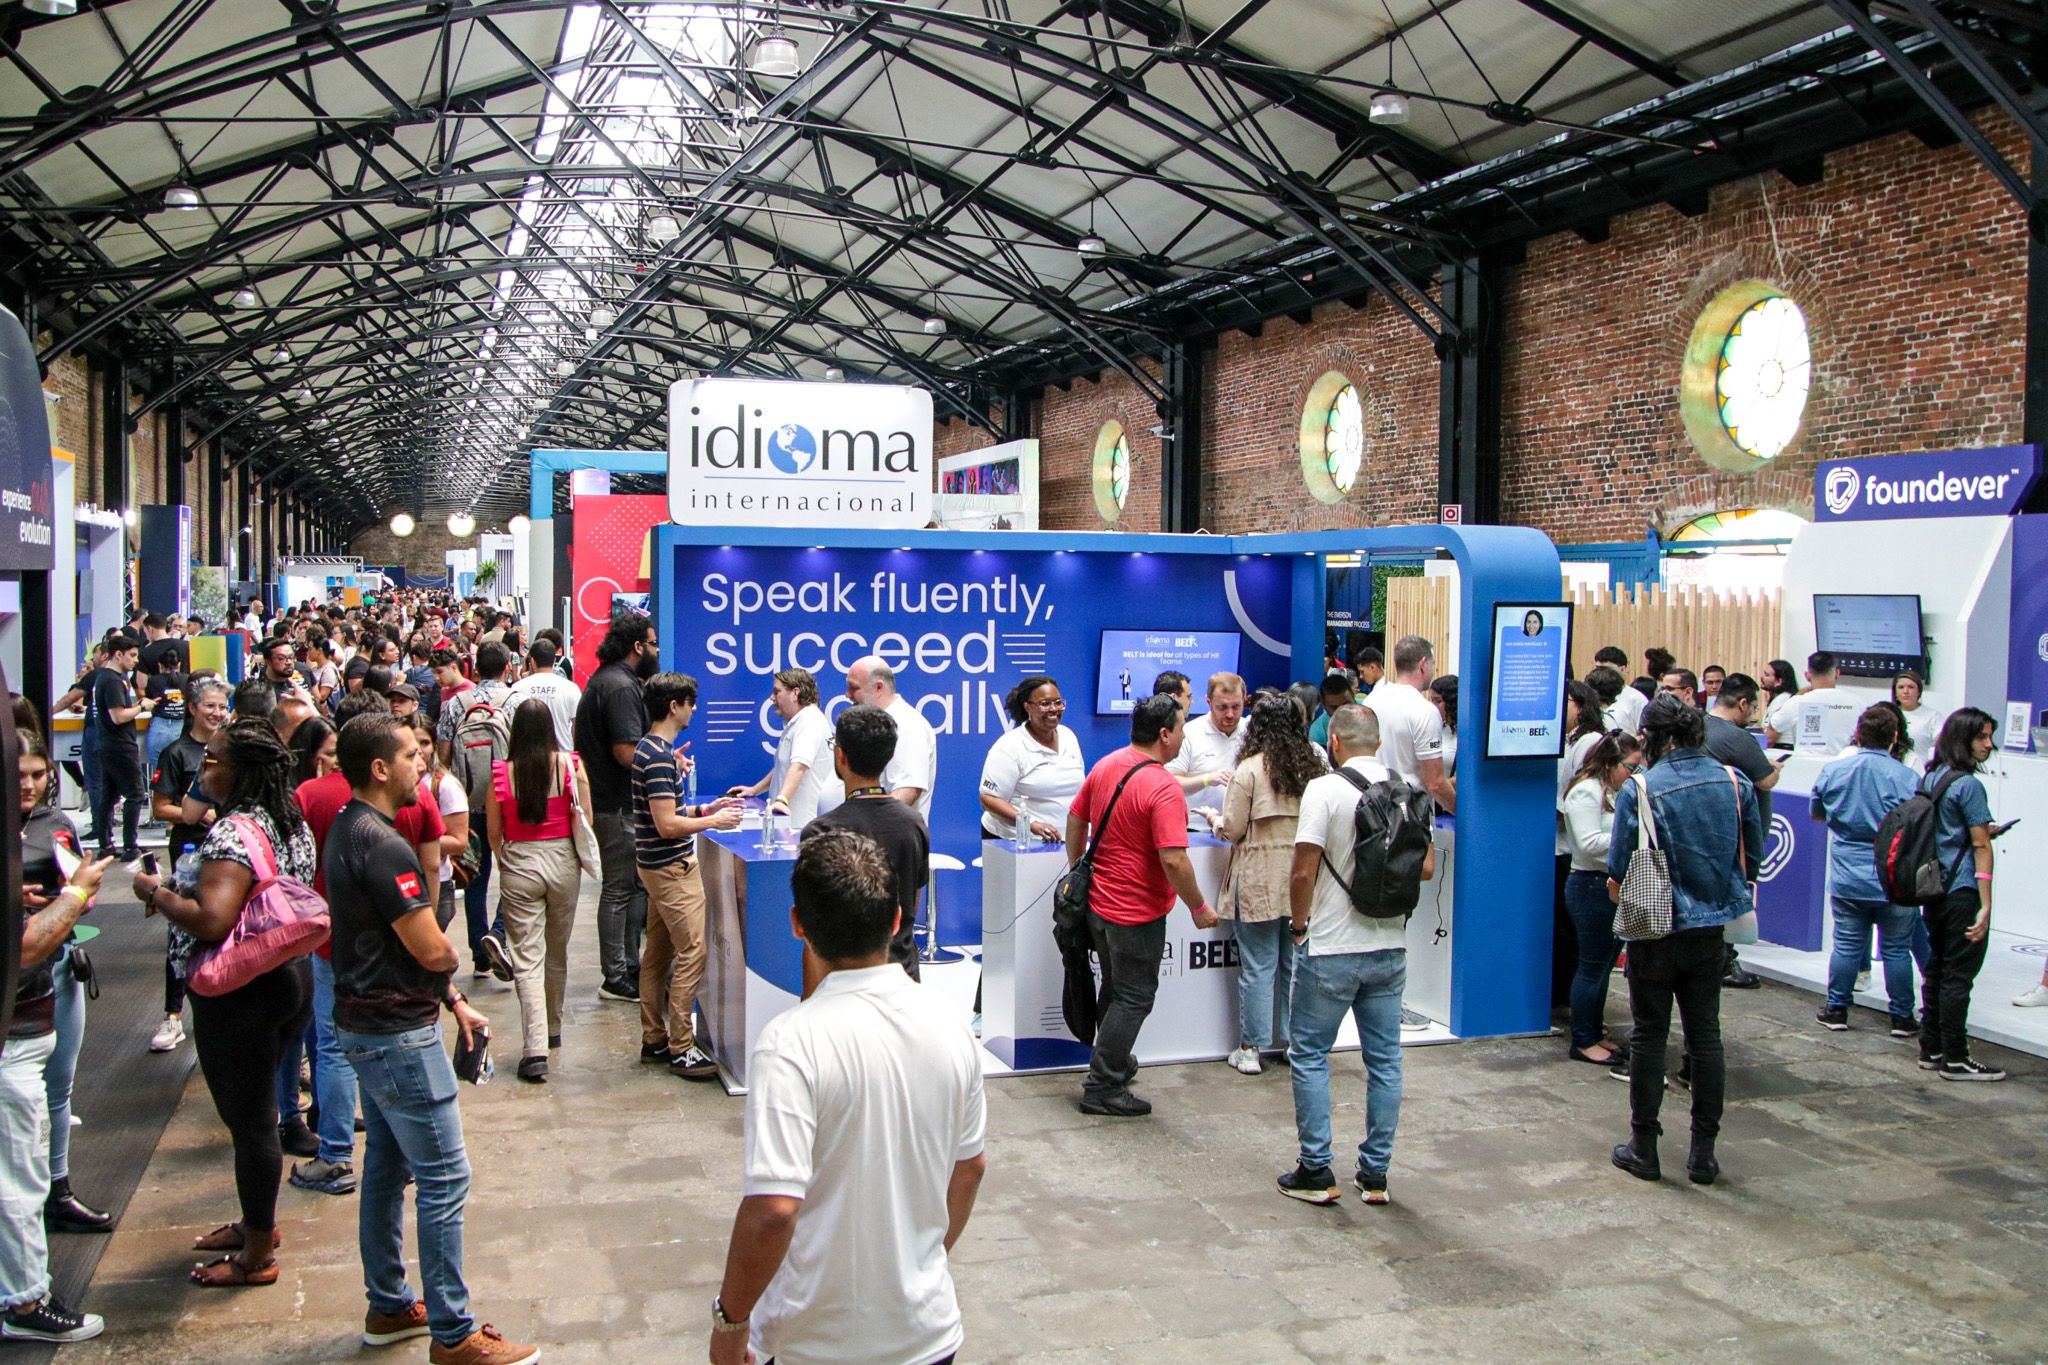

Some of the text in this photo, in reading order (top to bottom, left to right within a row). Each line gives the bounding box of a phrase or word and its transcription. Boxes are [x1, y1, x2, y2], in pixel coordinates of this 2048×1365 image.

[691, 404, 919, 474] idioma
[2, 488, 32, 512] experience
[691, 488, 914, 512] internacional
[1865, 471, 2009, 505] foundever
[20, 516, 51, 545] evolution
[702, 572, 1055, 626] Speak fluently,
[1327, 620, 1353, 628] MANAGEMENT
[705, 620, 996, 676] succeed
[530, 686, 557, 695] STAFF
